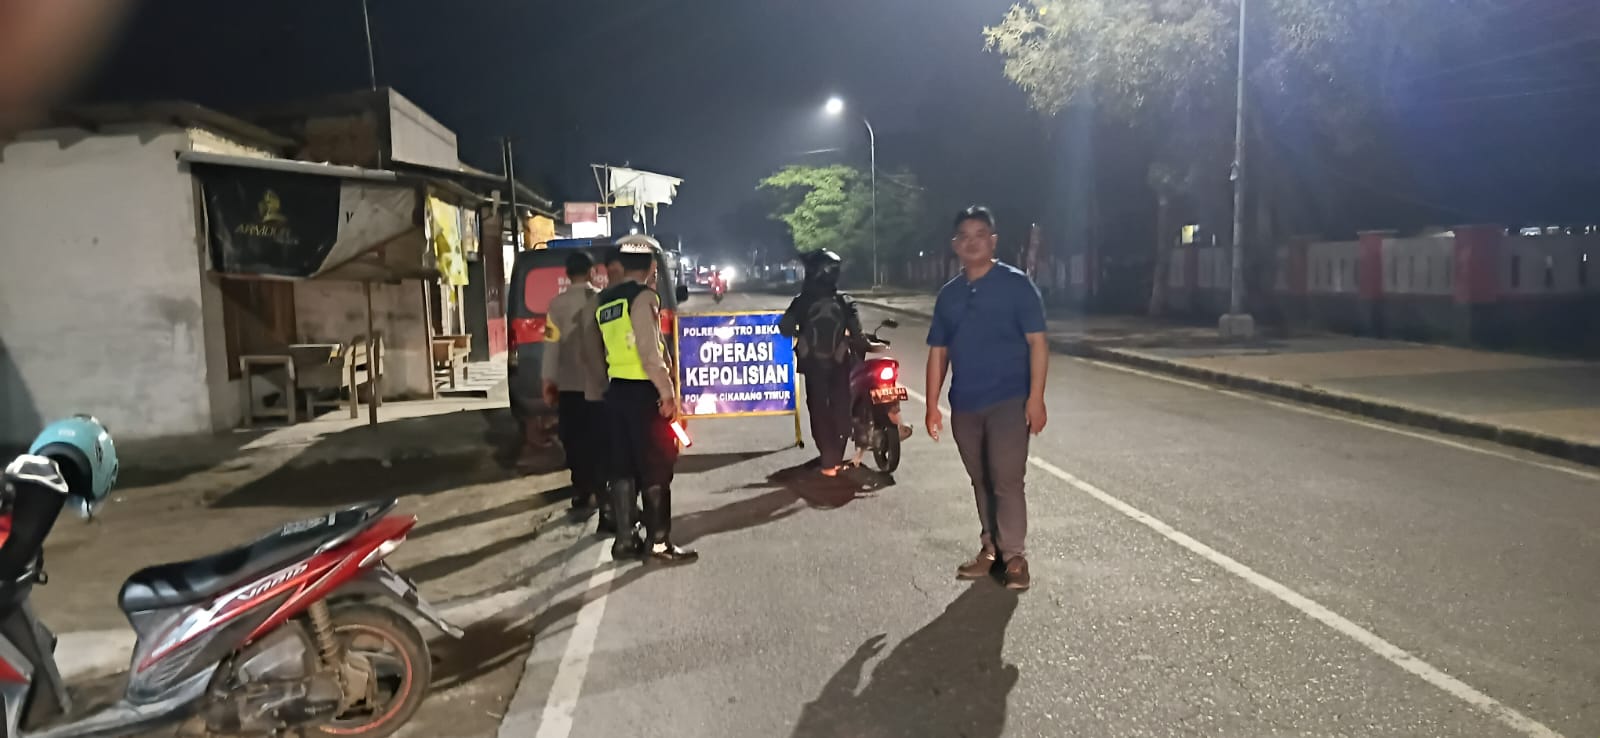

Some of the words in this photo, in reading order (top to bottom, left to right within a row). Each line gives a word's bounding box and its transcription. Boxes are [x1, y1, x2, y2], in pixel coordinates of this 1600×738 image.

[684, 327, 718, 336] POLRE
[720, 326, 753, 335] TRO
[755, 325, 781, 335] BEKA
[700, 342, 772, 363] OPERASI
[686, 364, 789, 386] KEPOLISIAN
[719, 391, 762, 401] CIKARANG
[764, 390, 790, 400] TIMUR
